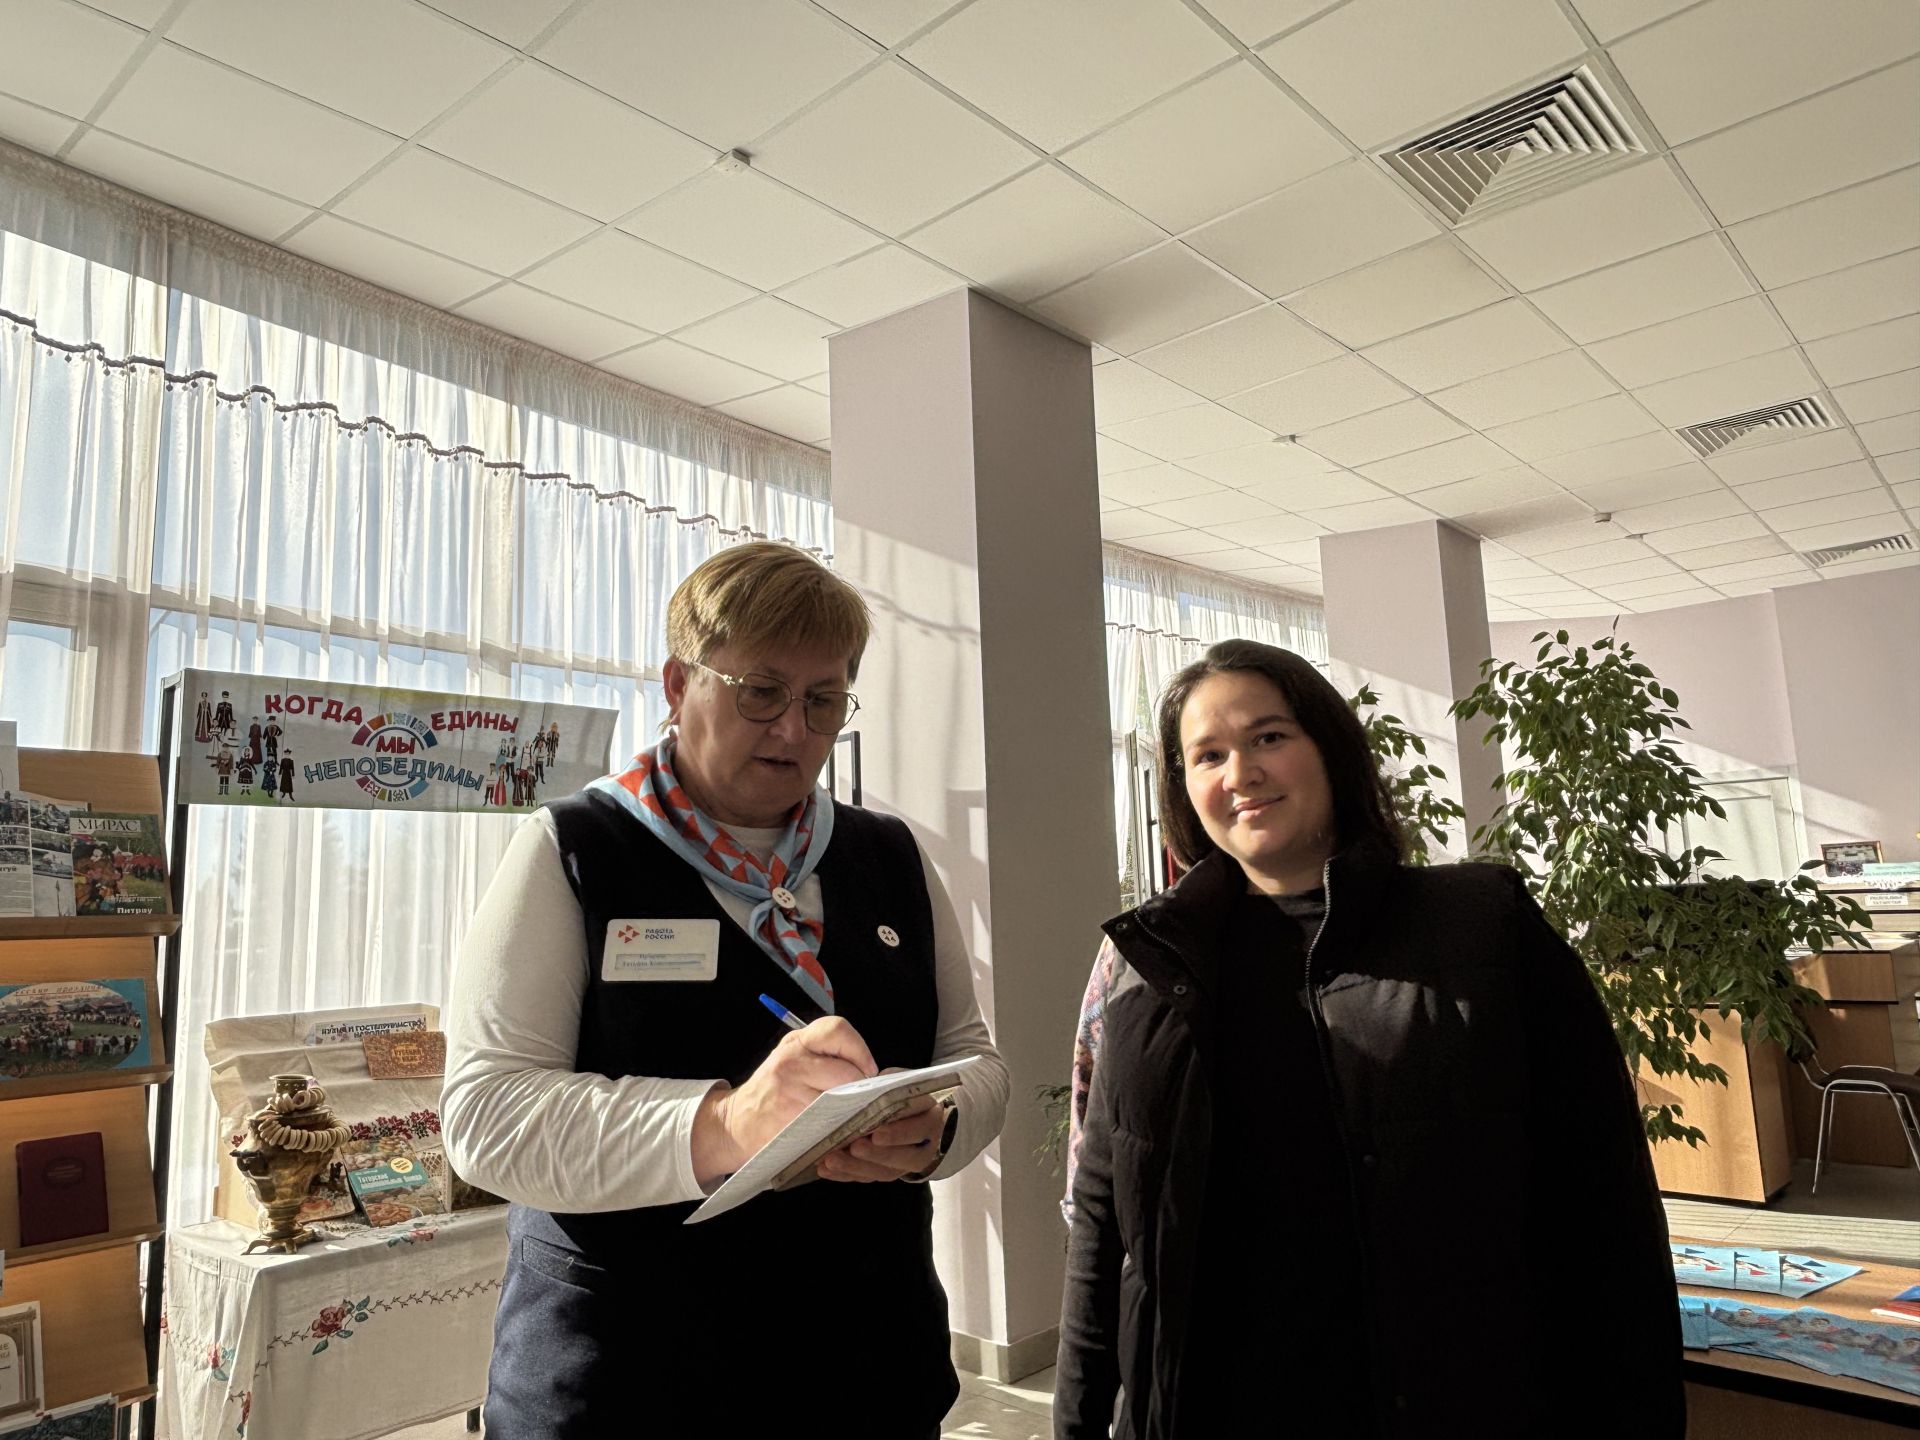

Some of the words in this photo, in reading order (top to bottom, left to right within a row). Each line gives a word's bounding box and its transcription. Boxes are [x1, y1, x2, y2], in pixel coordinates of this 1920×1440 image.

[264, 694, 363, 726] КОГДА
[431, 710, 519, 733] ЕДИНЫ
[375, 735, 416, 755] МЫ
[304, 756, 485, 791] НЕПОБЕДИМЫ
[78, 818, 138, 831] МИРАС
